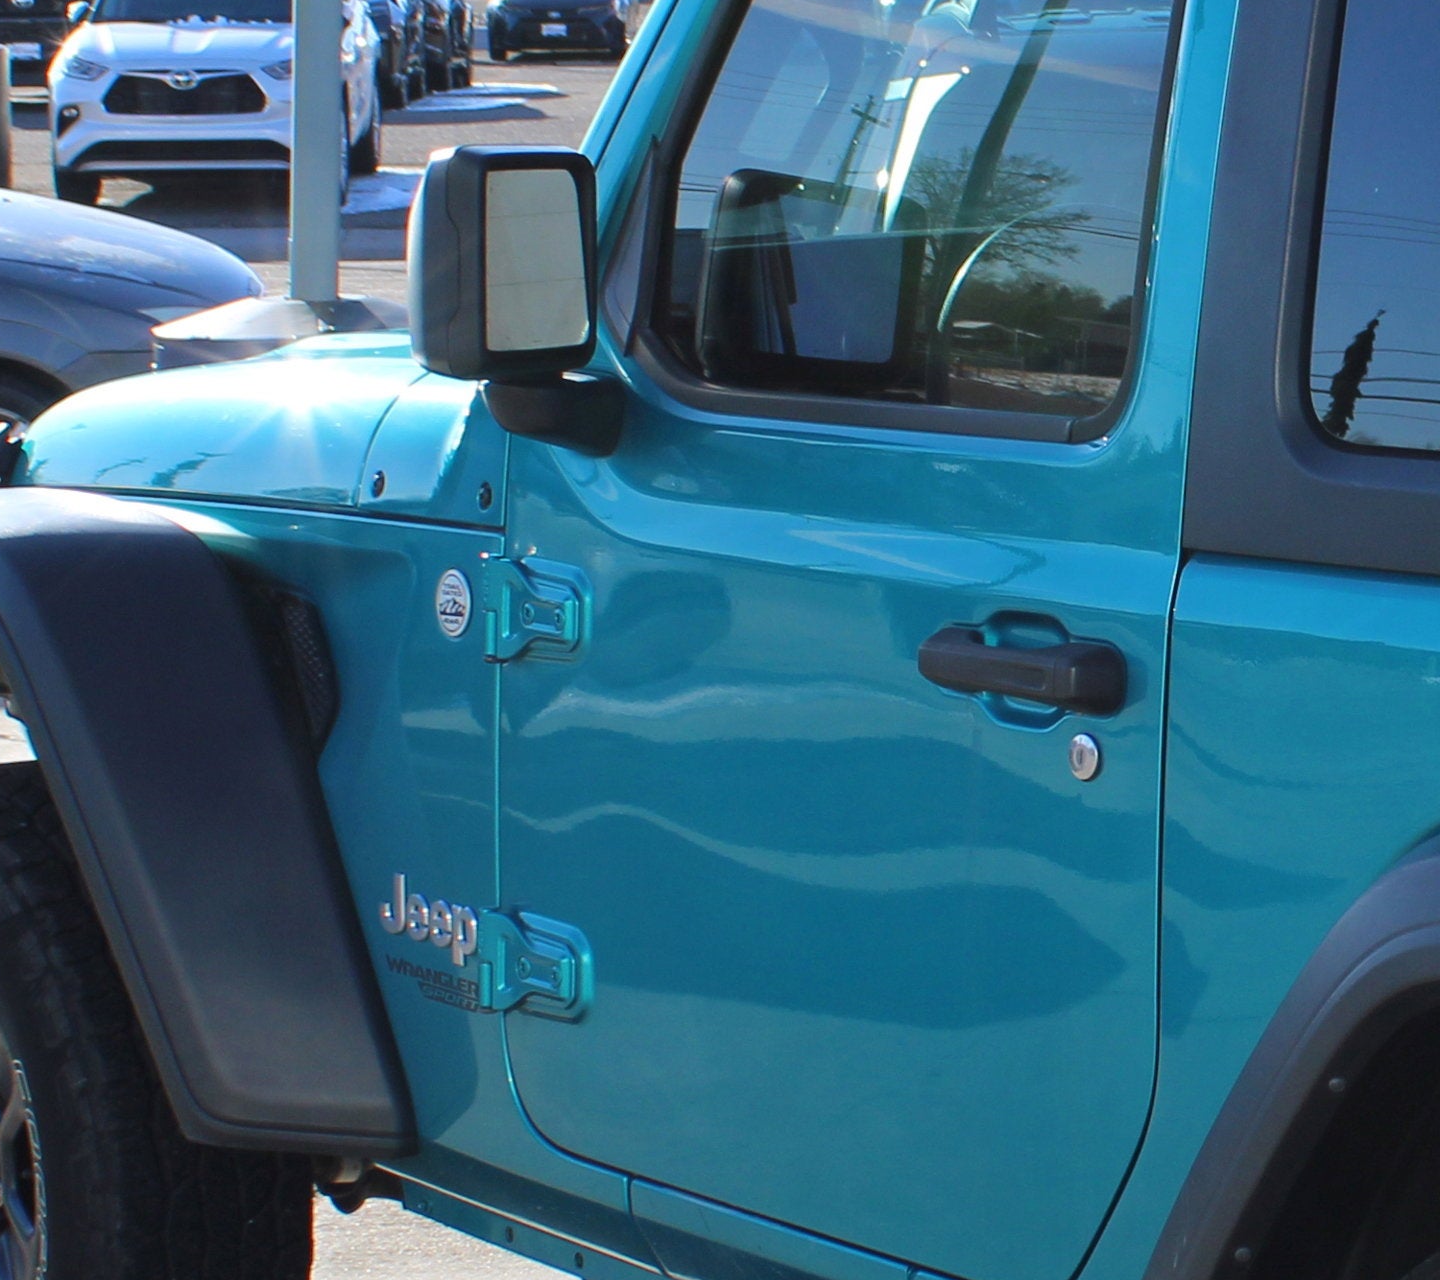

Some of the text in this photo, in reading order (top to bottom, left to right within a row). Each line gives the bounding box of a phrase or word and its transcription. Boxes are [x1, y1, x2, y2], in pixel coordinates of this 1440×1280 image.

[379, 872, 478, 966] Jeep
[386, 953, 479, 998] WRANGLER
[422, 984, 478, 1010] SPORT
